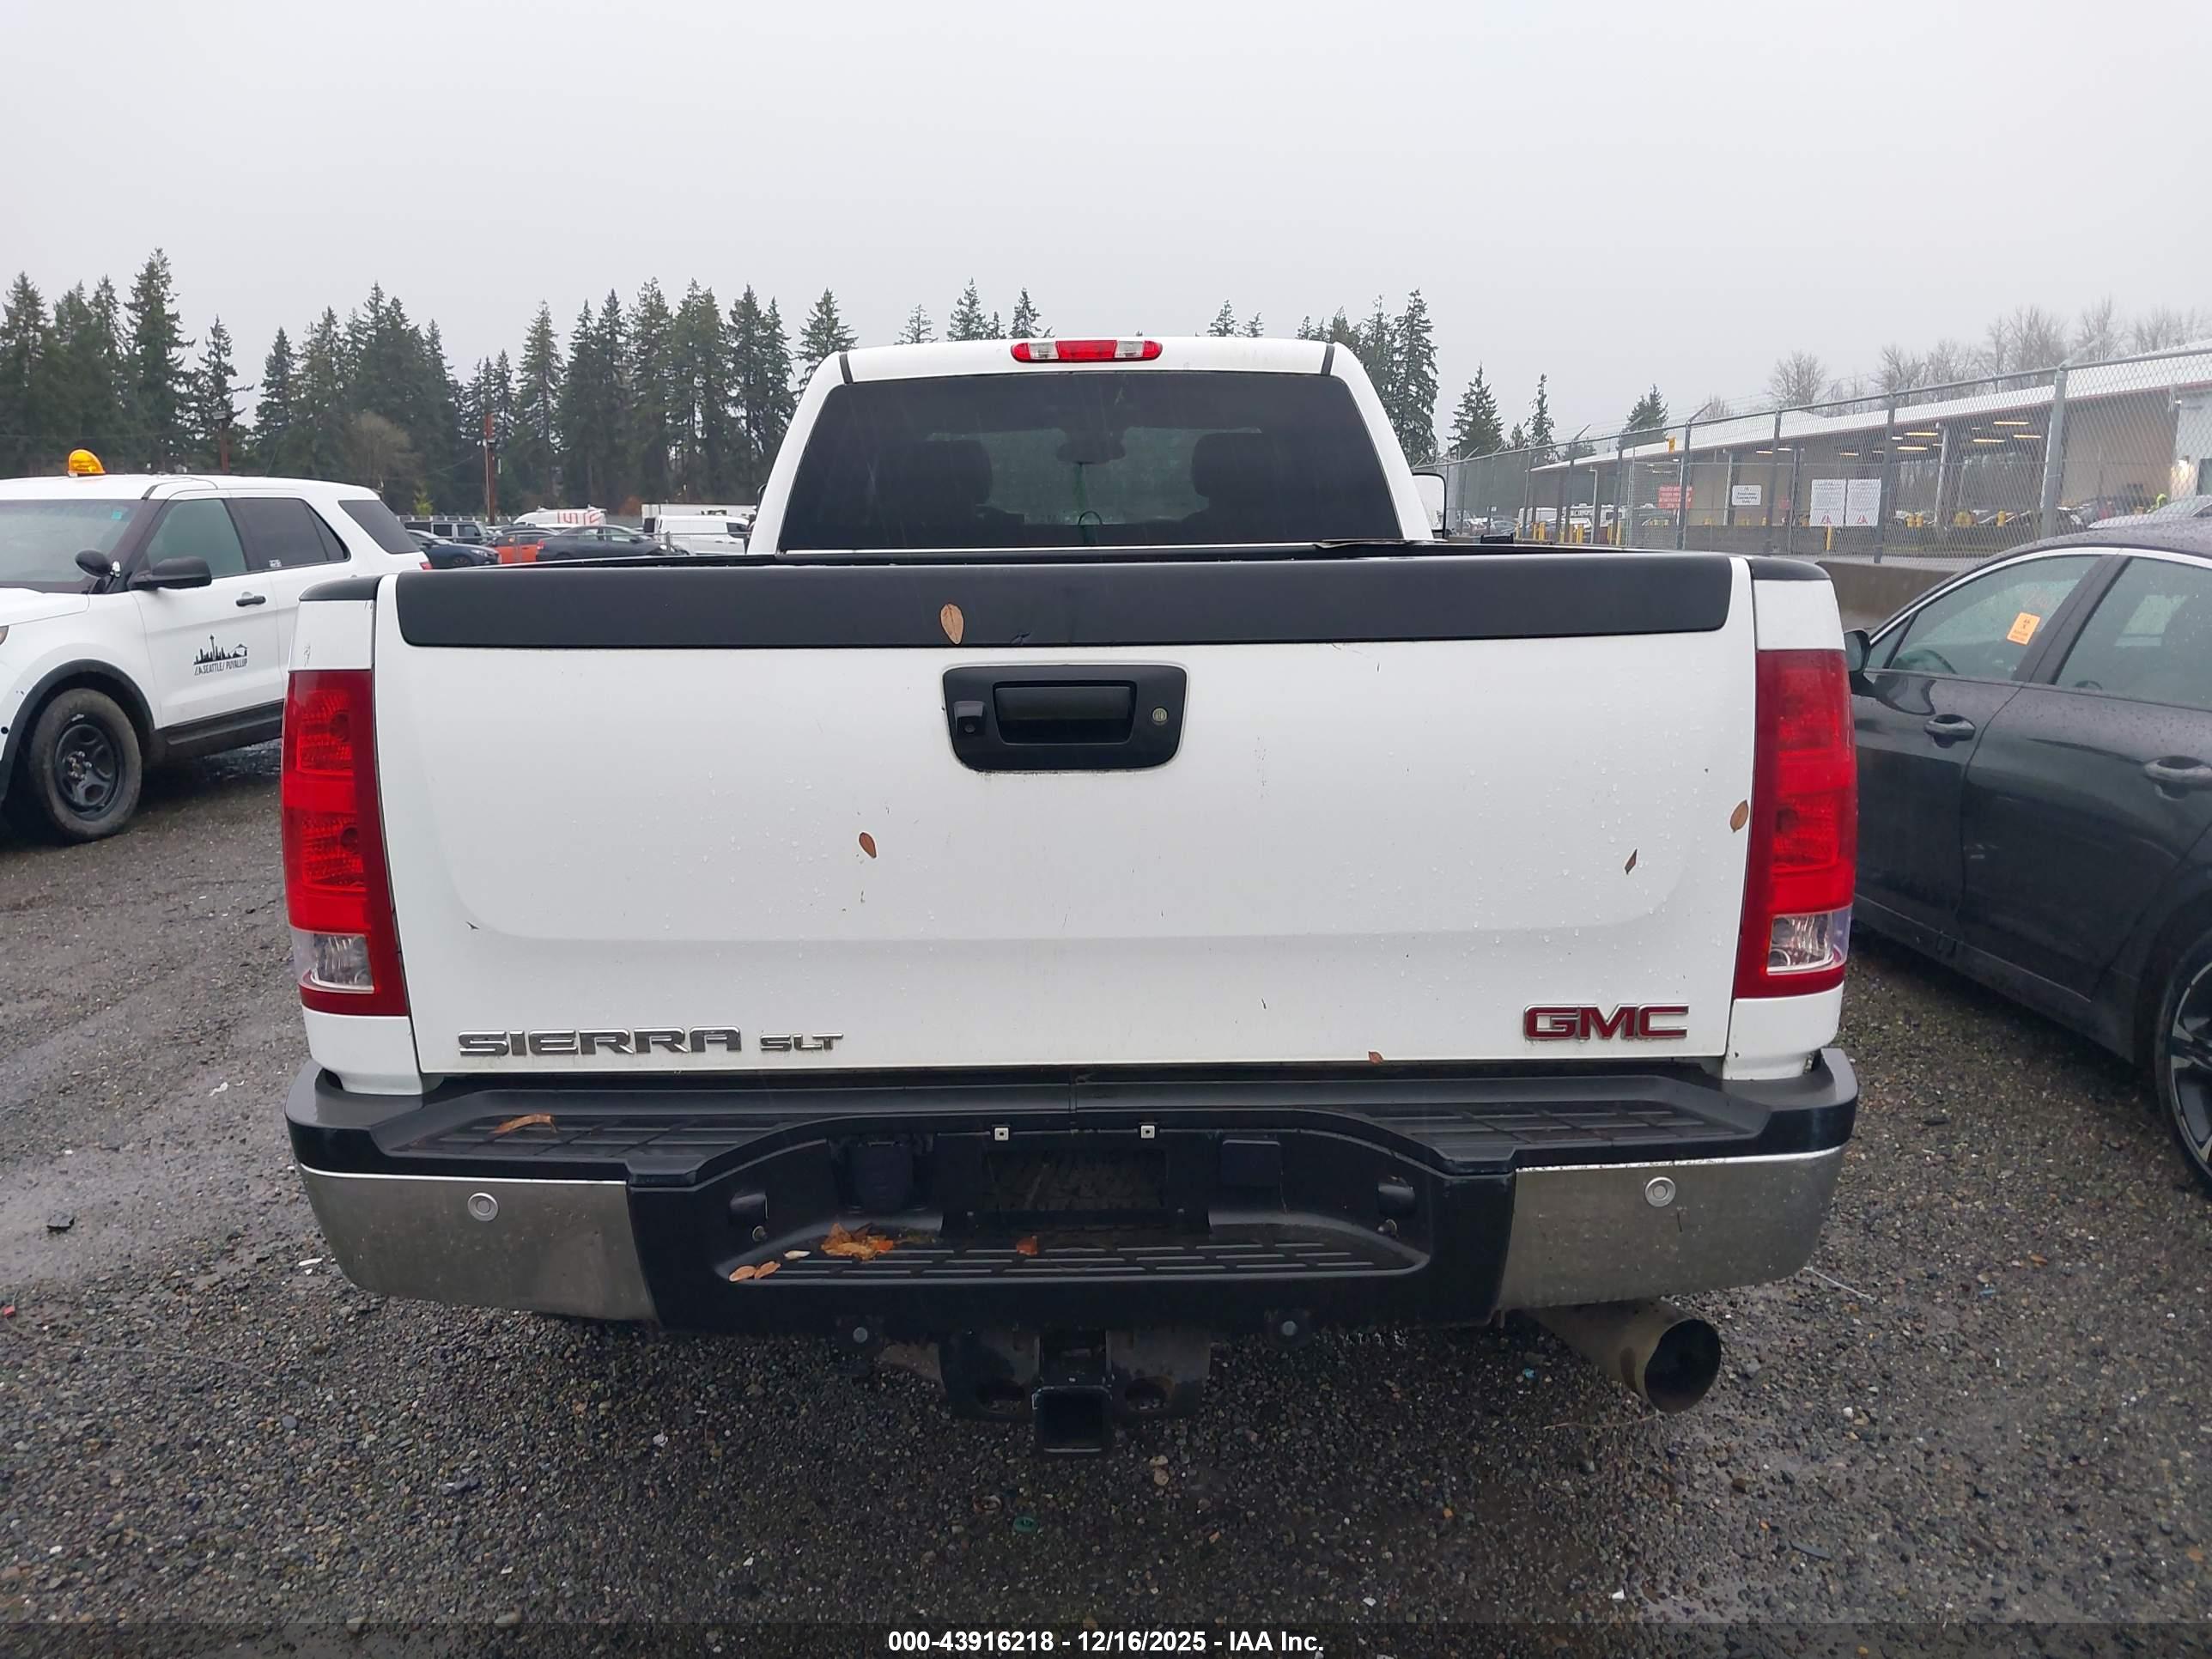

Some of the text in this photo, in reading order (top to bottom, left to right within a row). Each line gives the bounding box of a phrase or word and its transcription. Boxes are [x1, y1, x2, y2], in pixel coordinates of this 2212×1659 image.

[1524, 1004, 1689, 1041] GMC
[459, 1026, 844, 1056] SIERRA SLT
